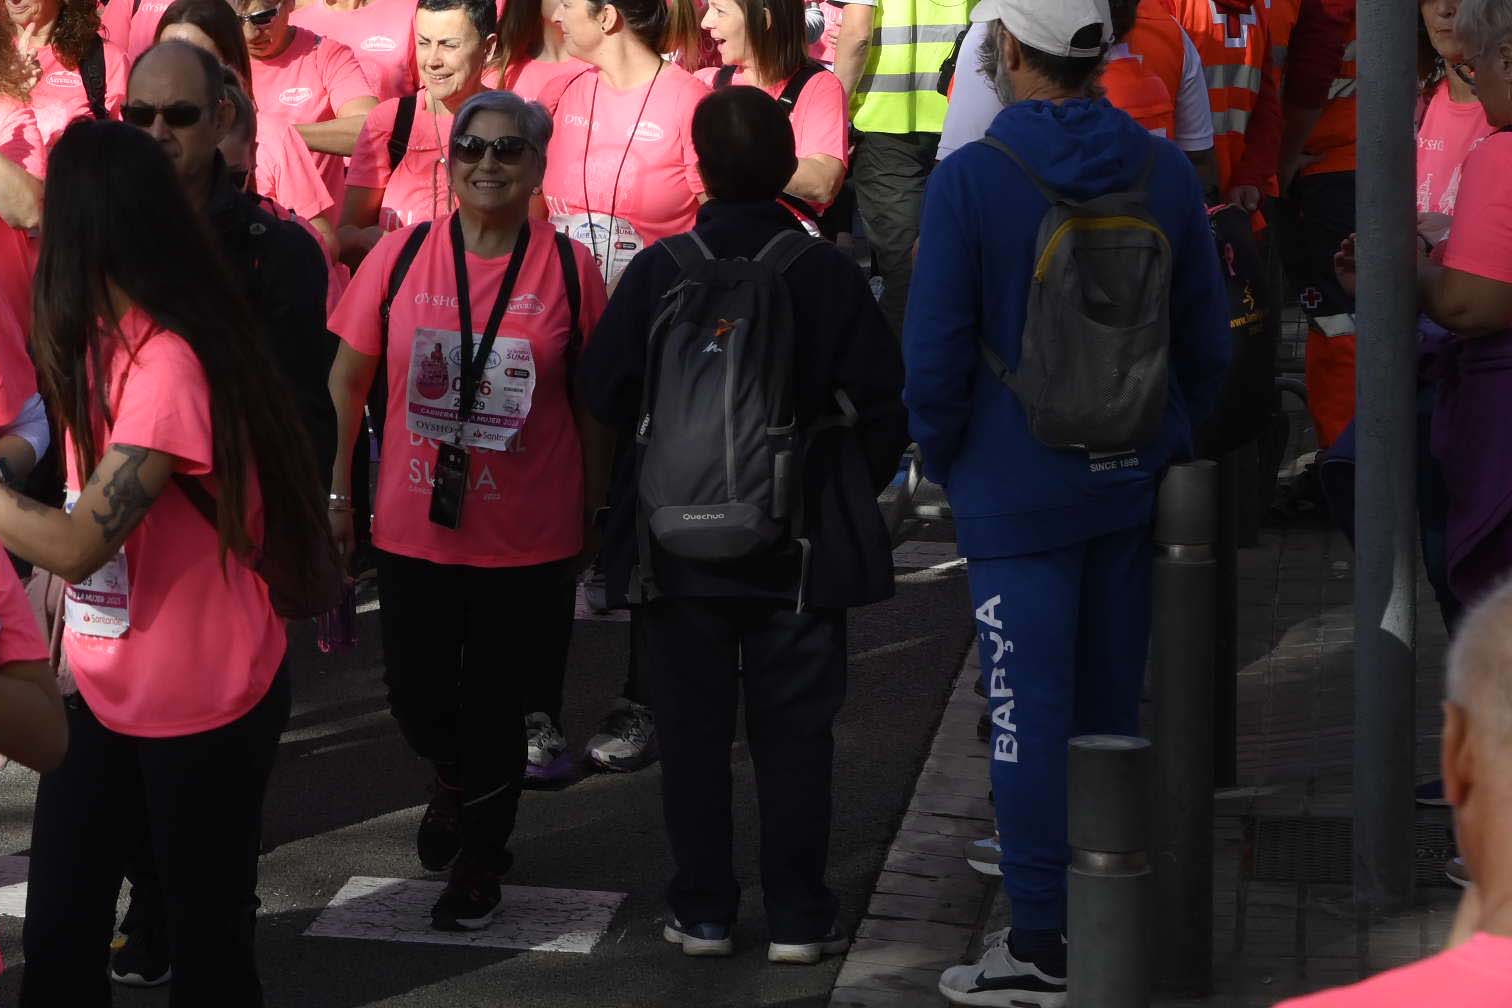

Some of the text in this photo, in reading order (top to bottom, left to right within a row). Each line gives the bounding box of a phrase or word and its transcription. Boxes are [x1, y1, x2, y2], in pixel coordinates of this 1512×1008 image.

[1089, 460, 1118, 473] SINCE
[682, 511, 725, 521] Quechua
[975, 594, 1019, 764] BARÇA
